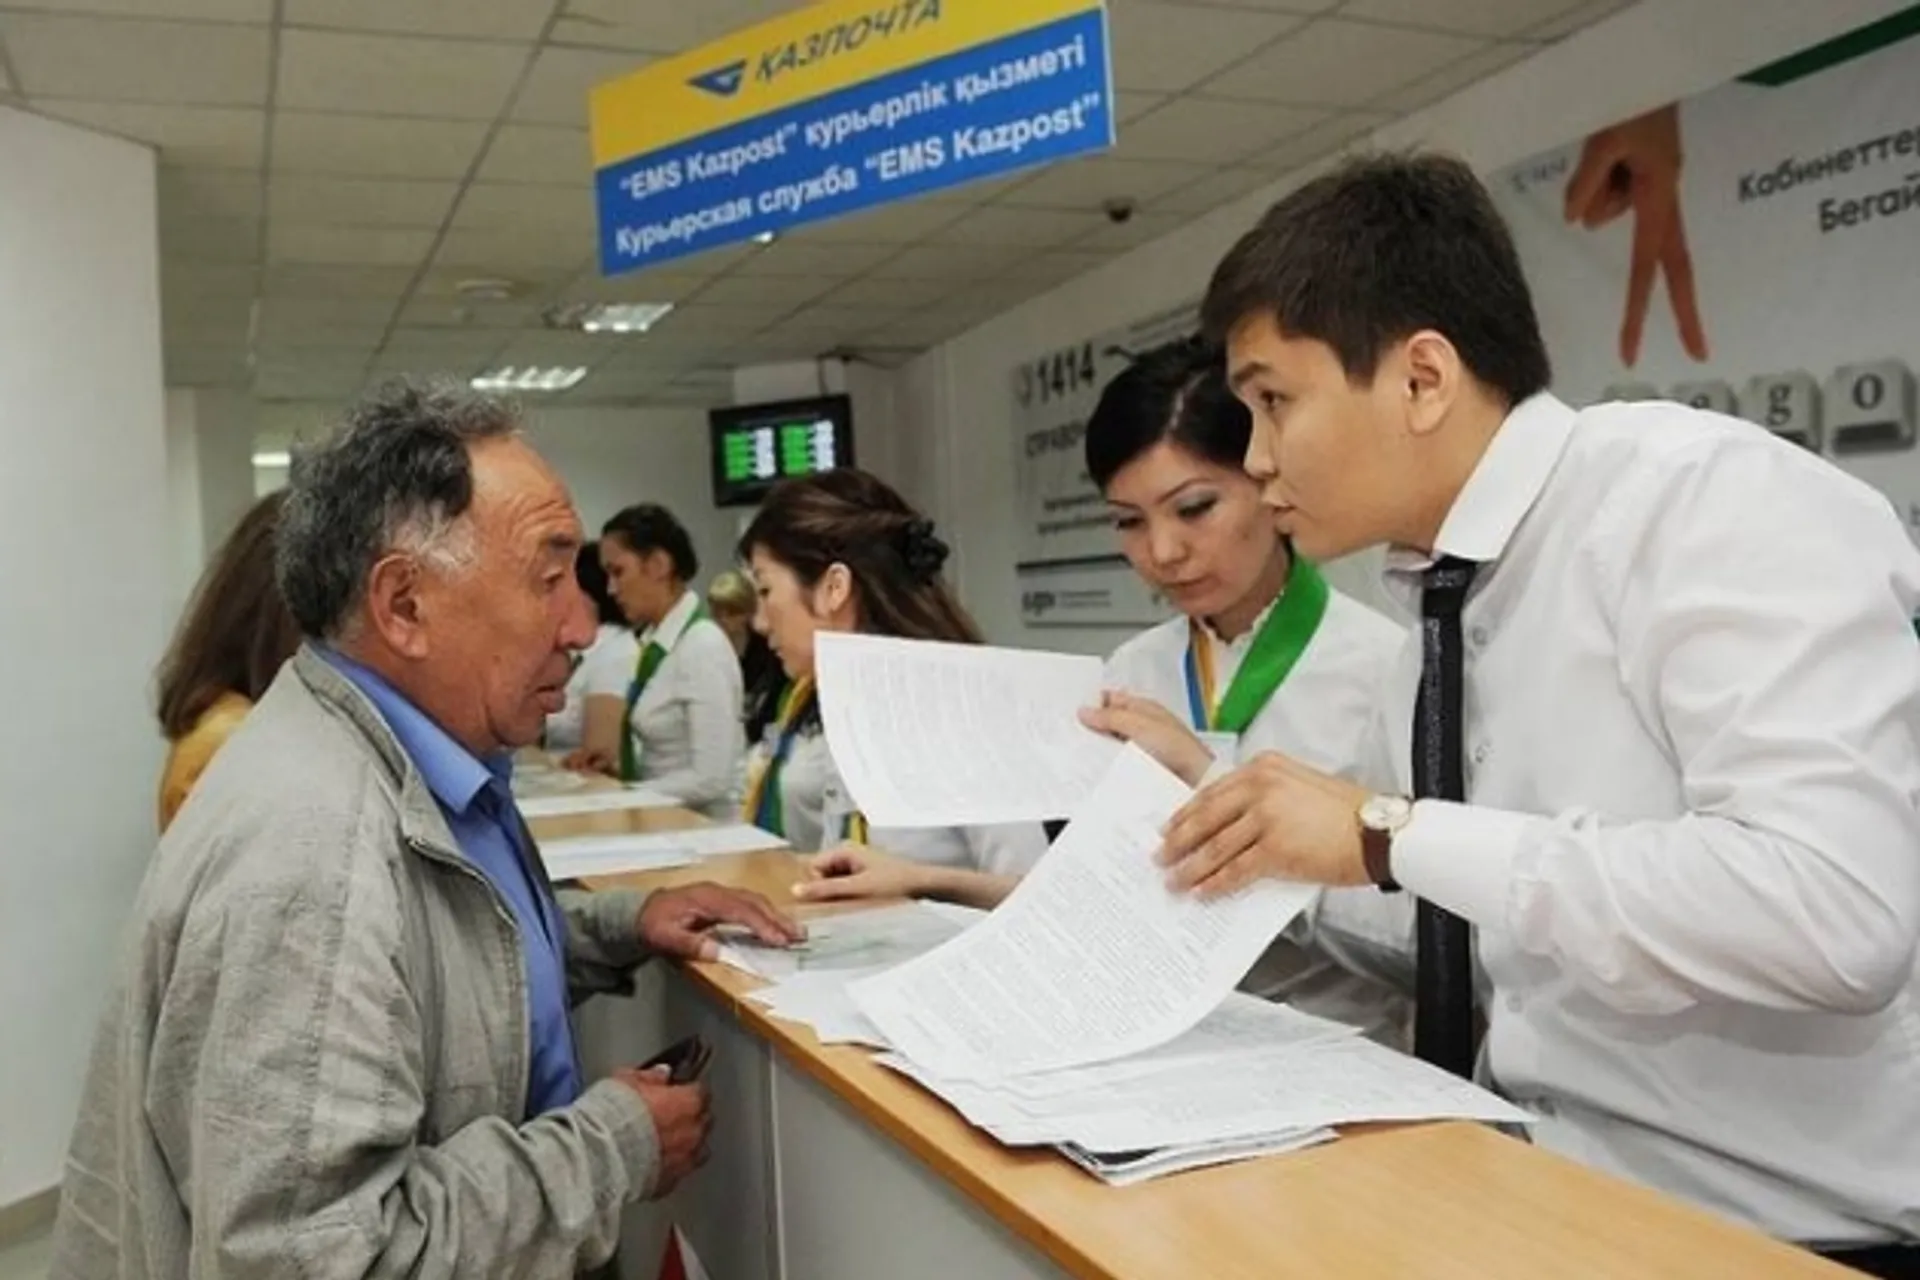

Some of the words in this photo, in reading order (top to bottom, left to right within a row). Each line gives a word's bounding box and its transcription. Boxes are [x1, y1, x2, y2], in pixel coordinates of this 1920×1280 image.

[805, 82, 948, 149] курьерлік
[953, 34, 1086, 103] қызметі
[615, 197, 753, 258] Курьерская
[758, 164, 858, 213] служба
